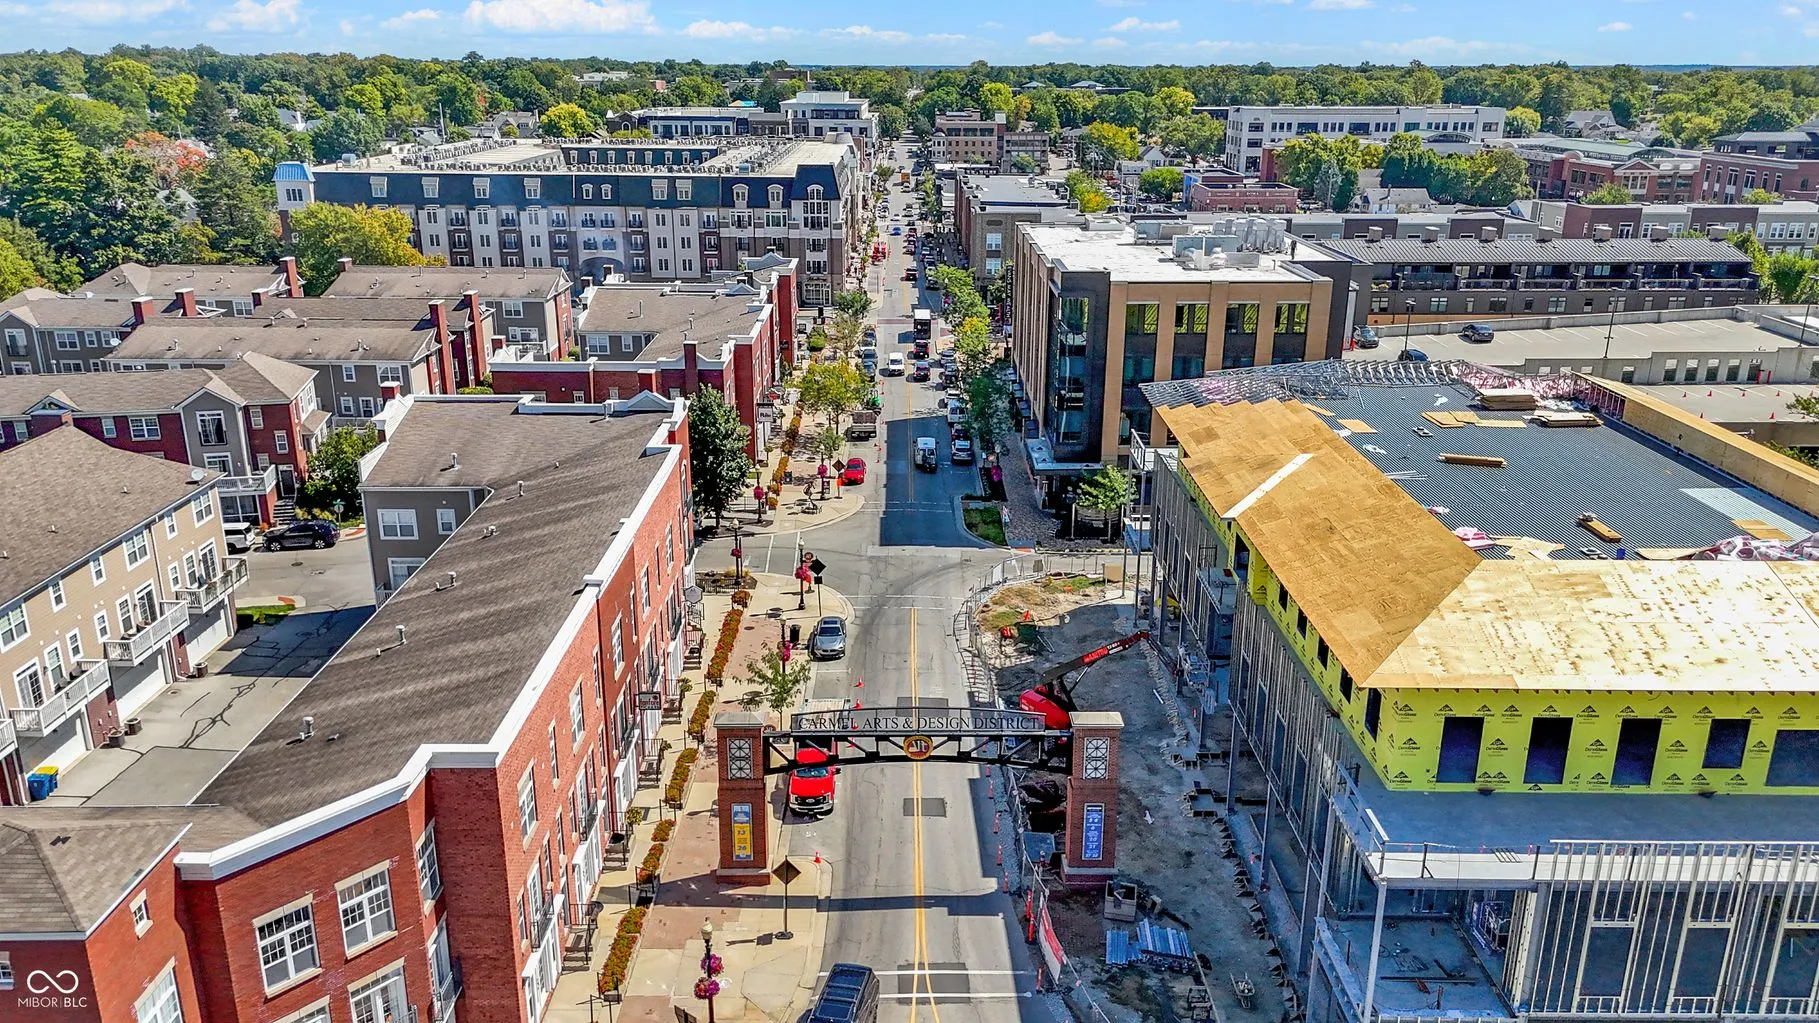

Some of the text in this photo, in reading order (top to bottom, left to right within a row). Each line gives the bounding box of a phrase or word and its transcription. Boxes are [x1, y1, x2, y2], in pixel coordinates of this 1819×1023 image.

[798, 717, 1040, 730] CARMEL ARTS & DESIGN DISTRICT
